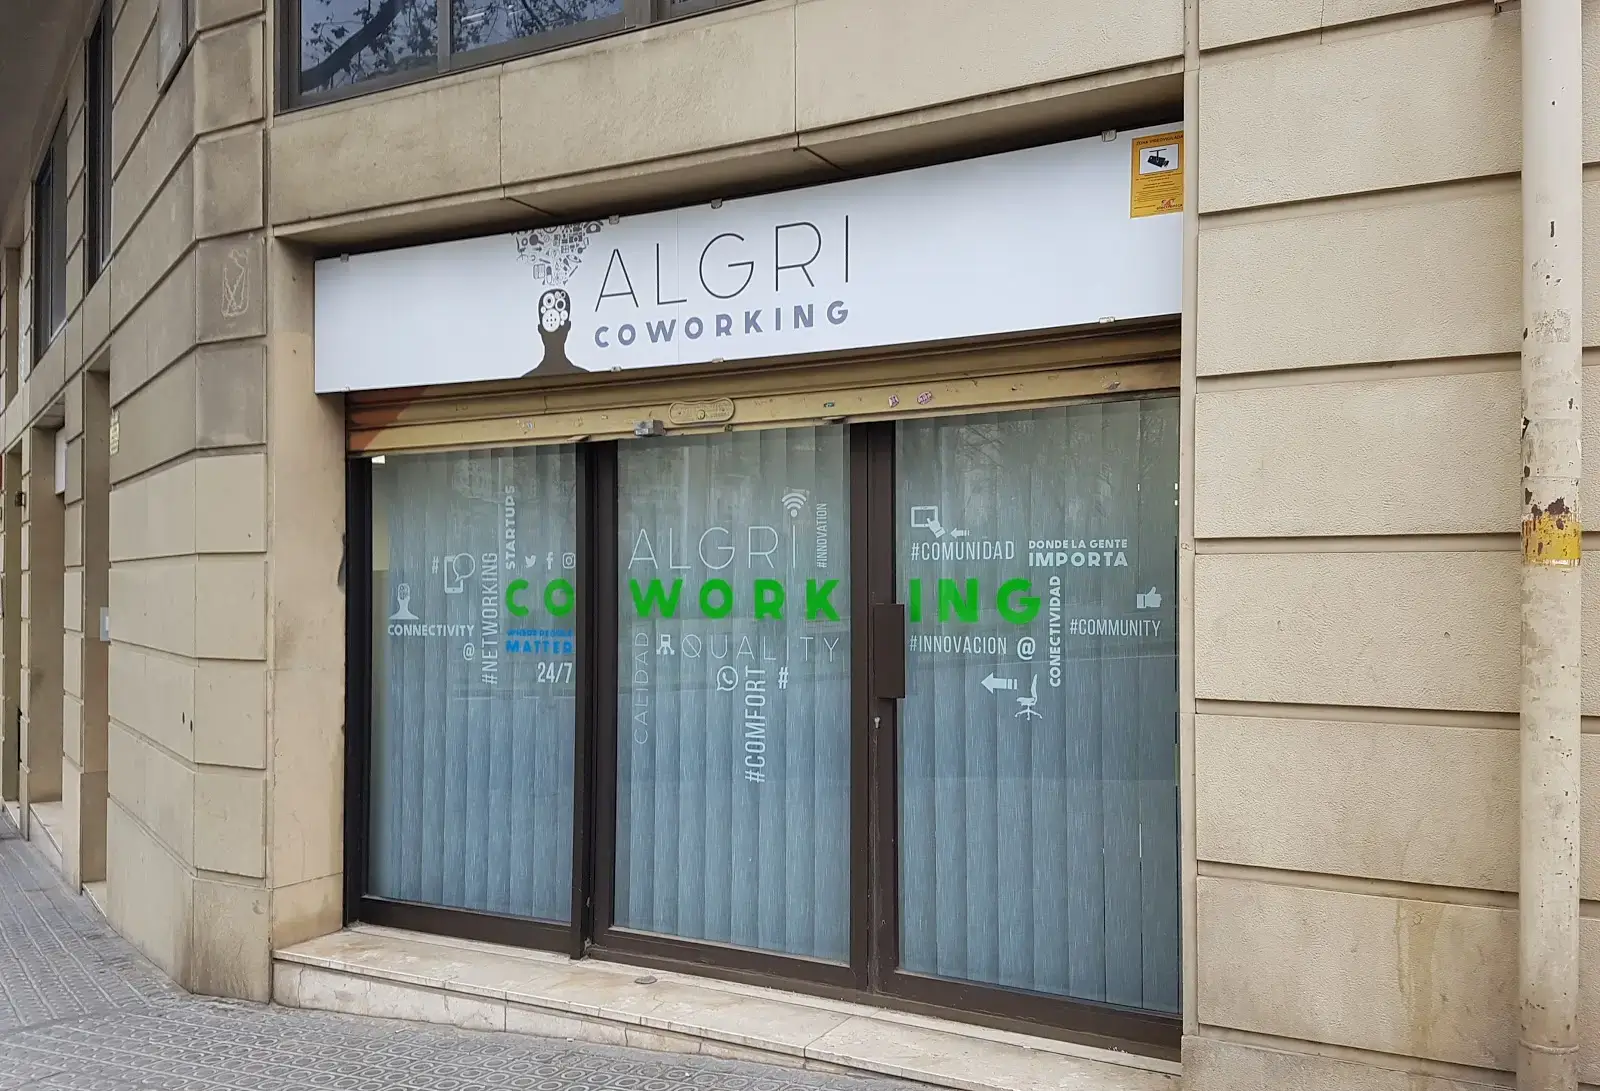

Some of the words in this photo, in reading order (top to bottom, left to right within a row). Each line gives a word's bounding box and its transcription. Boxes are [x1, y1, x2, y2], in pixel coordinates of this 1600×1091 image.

[595, 214, 849, 312] ALGRI
[595, 300, 849, 348] COWORKING
[505, 485, 516, 570] STARTUPS
[816, 502, 828, 568] #INNOVATION
[1028, 539, 1069, 549] DONDE
[1071, 539, 1086, 549] LA
[1089, 538, 1128, 549] GENTE
[628, 524, 797, 570] ALGRI
[911, 540, 1016, 561] #COMUNIDAD
[1028, 551, 1129, 567] IMPORTA
[387, 624, 475, 637] CONNECTIVITY
[481, 552, 498, 685] #NETWORKING
[1049, 575, 1061, 688] CONECTIVIDAD
[1069, 619, 1161, 637] #COMMUNITY
[506, 640, 573, 654] MATTER
[681, 633, 840, 663] QUALITY
[909, 636, 1008, 655] #INNOVACION
[537, 661, 573, 684] 24/7
[633, 632, 649, 745] CALIDAD
[744, 665, 766, 783] #COMFORT
